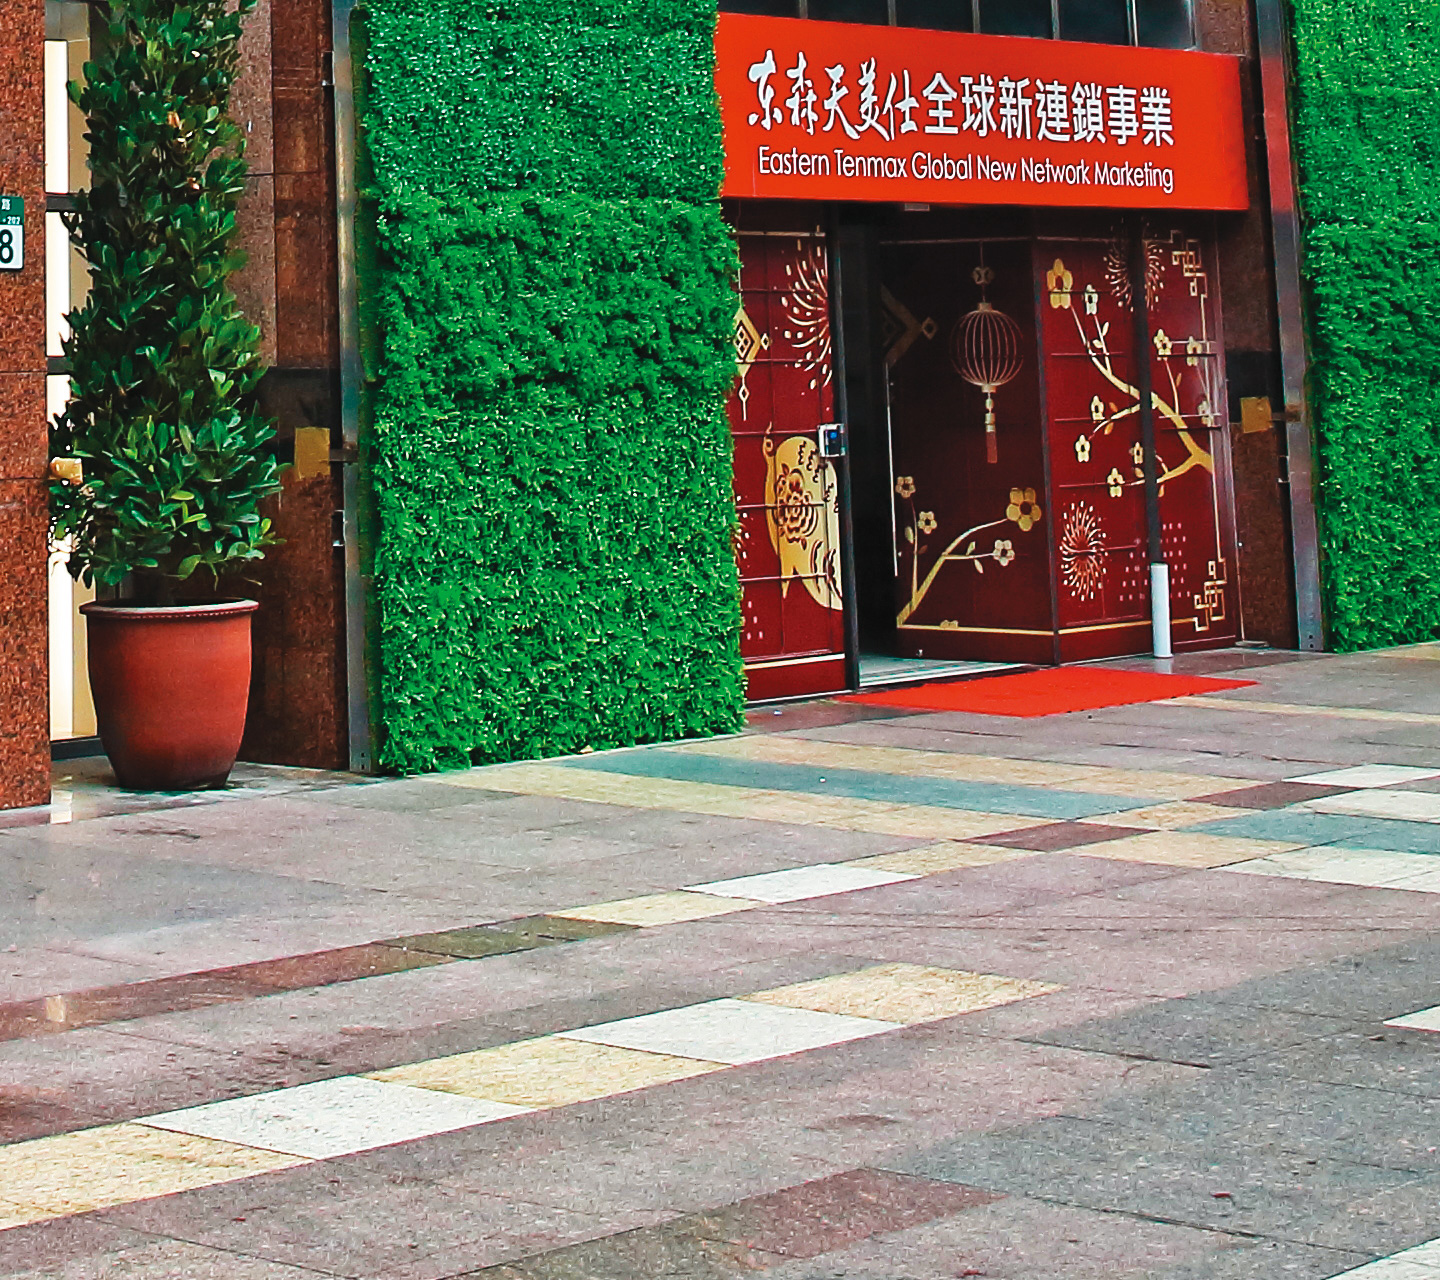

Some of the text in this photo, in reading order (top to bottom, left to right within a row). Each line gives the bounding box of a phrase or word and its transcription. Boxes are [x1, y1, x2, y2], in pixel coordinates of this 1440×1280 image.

[758, 145, 1174, 194] Eastern Tenmax Global New Network Marketing
